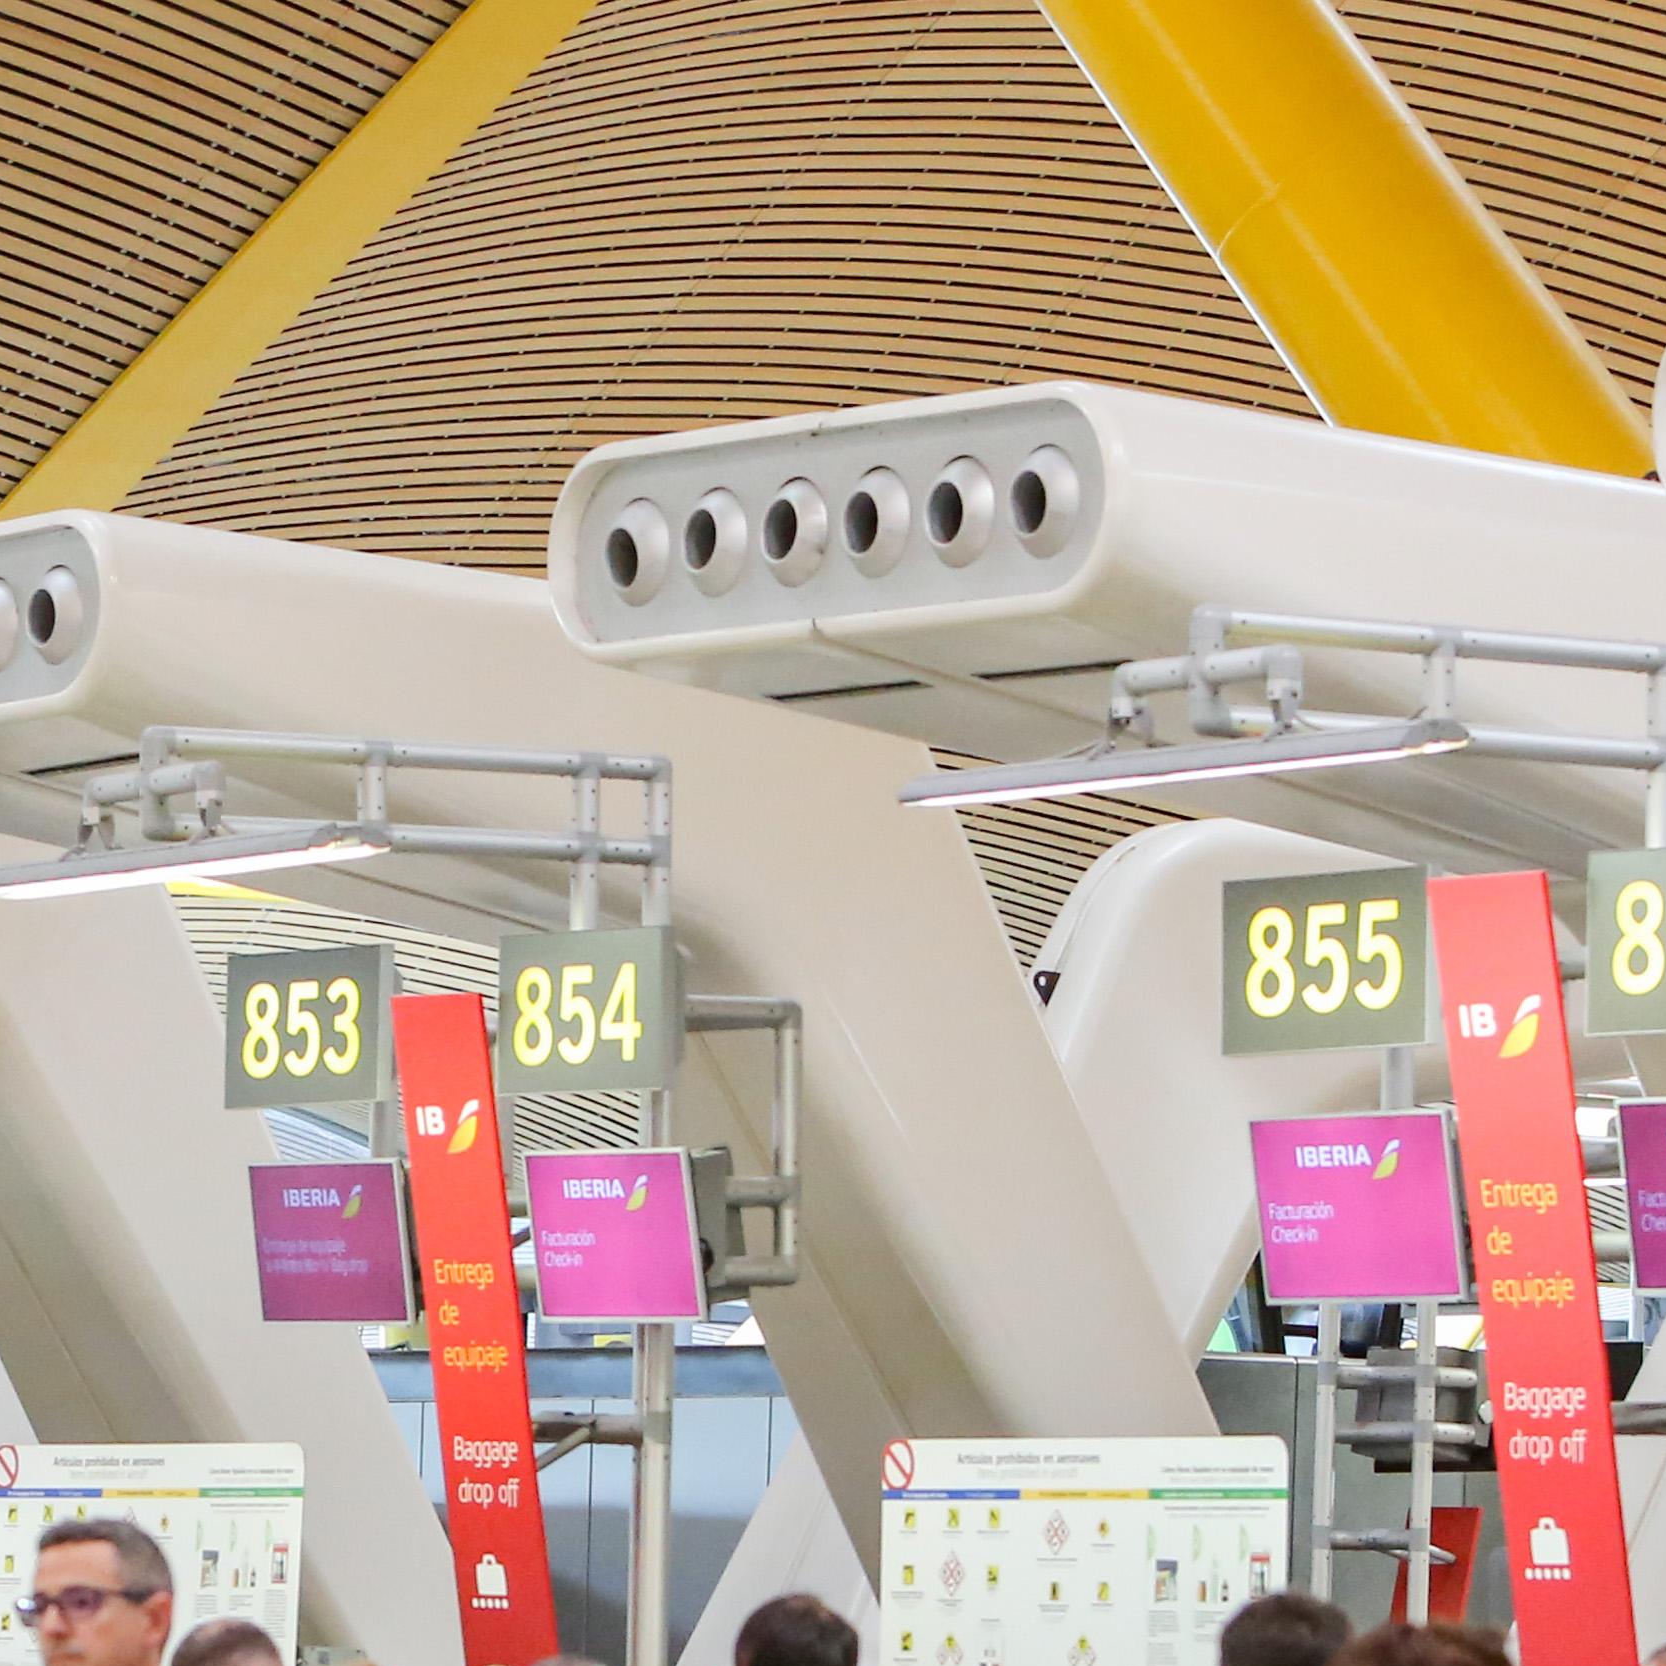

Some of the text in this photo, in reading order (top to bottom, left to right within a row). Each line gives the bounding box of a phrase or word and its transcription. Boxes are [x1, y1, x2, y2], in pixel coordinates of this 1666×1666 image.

[1245, 898, 1403, 1018] 855
[242, 977, 361, 1079] 853
[514, 962, 642, 1066] 854
[1459, 1004, 1497, 1038] IB
[416, 1106, 445, 1135] IB
[1295, 1145, 1371, 1168] IBERIA
[283, 1188, 341, 1207] IBERIA
[562, 1179, 625, 1199] IBERIA
[1480, 1178, 1558, 1214] Entrega
[1269, 1200, 1333, 1221] Facturación
[1486, 1226, 1513, 1255] de
[434, 1259, 494, 1290] Entrega
[1492, 1272, 1574, 1308] equipaje
[439, 1300, 460, 1325] de
[444, 1340, 508, 1373] equipaje
[1503, 1381, 1586, 1419] Baggage
[453, 1435, 519, 1468] Baggage
[1509, 1428, 1587, 1465] drop off
[458, 1476, 520, 1508] drop off
